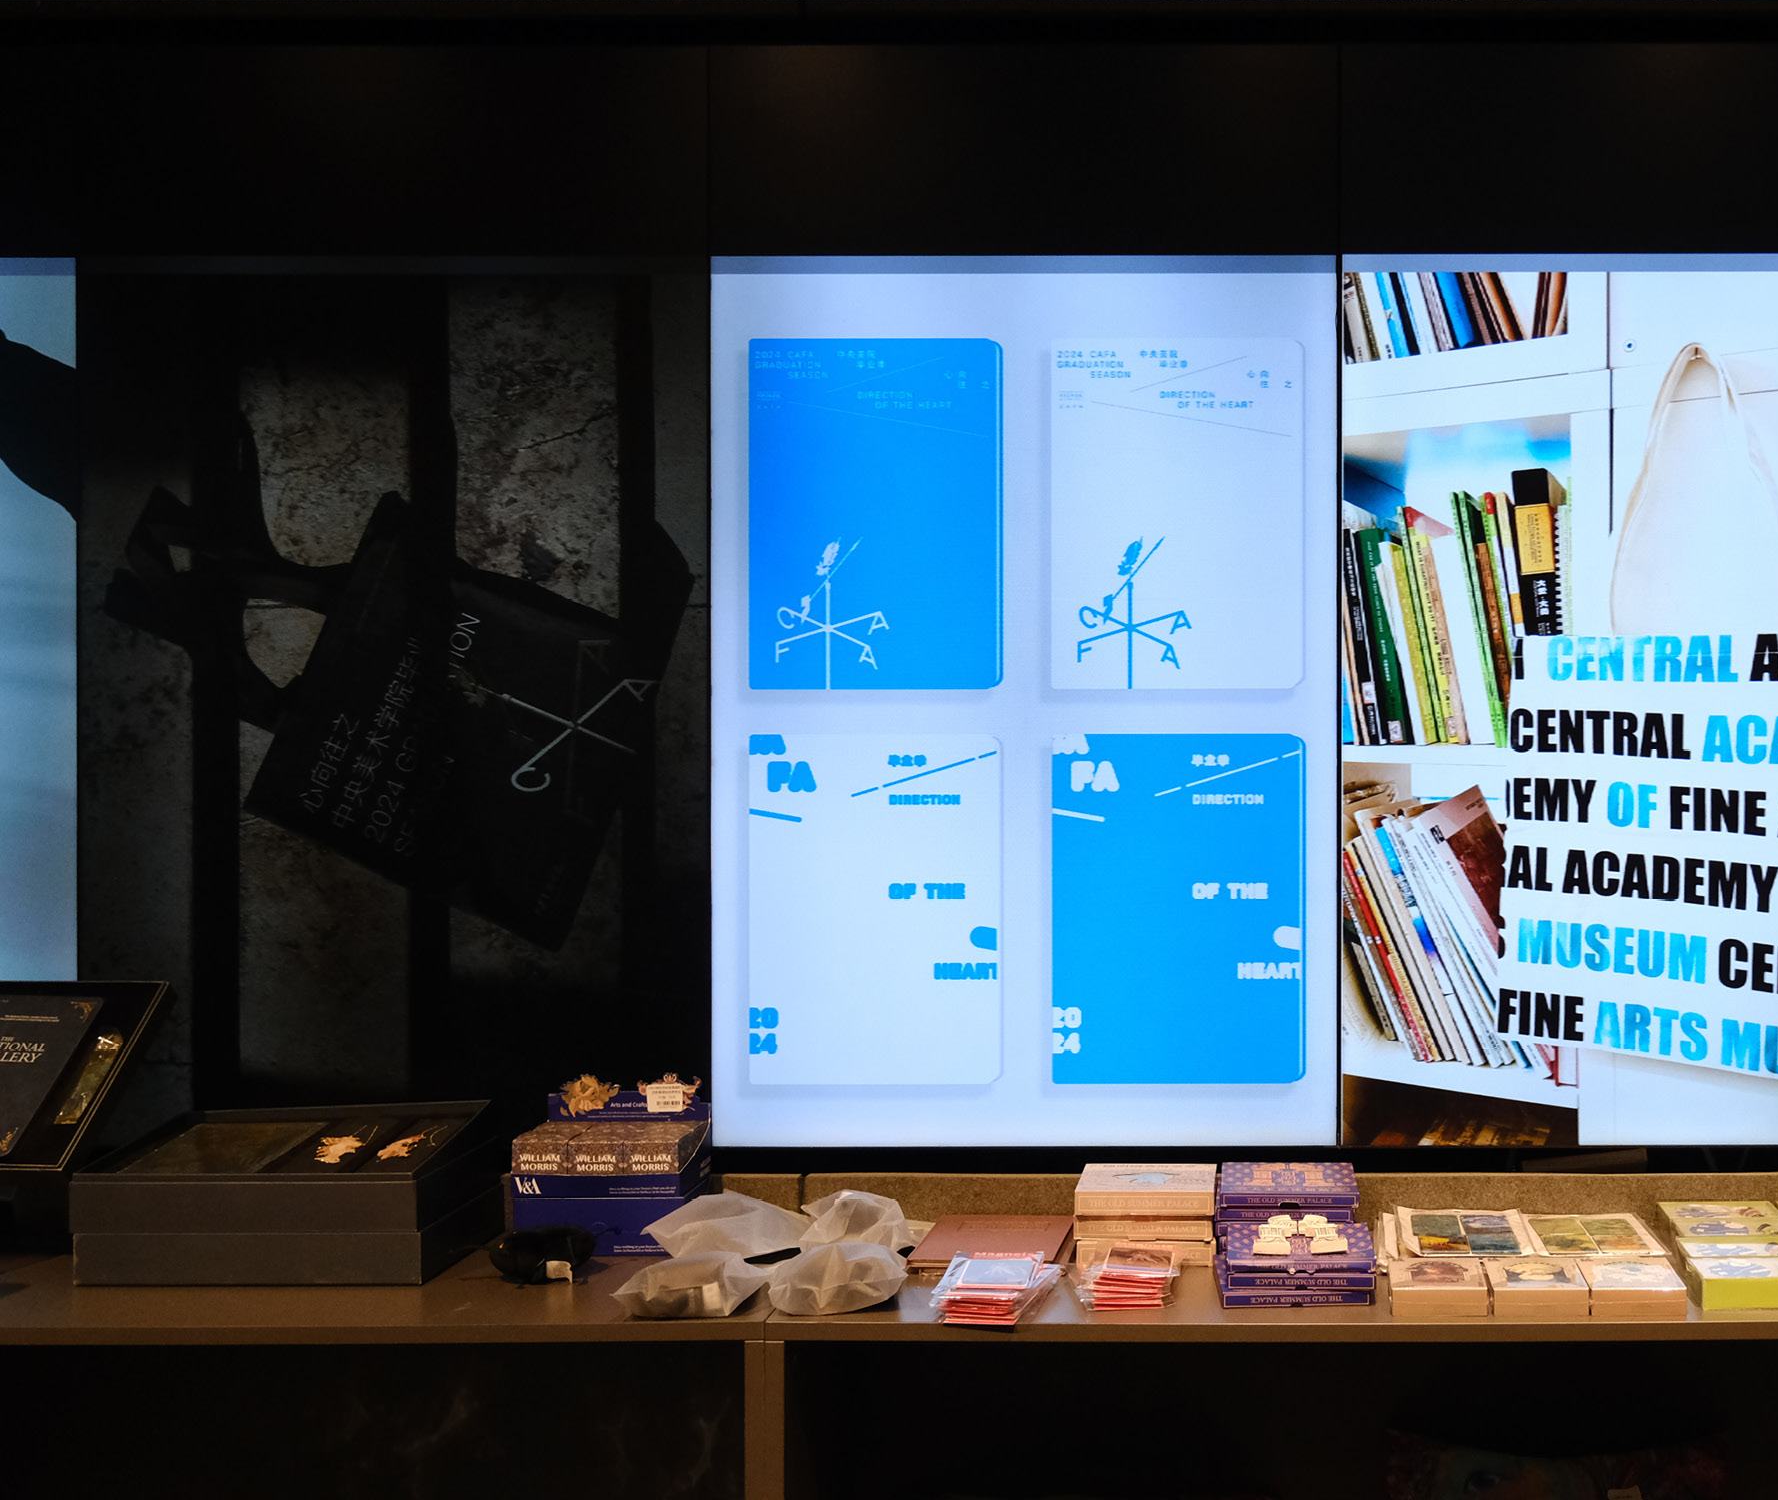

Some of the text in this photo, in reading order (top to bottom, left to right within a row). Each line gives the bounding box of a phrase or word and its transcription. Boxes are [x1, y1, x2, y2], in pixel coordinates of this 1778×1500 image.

[1547, 634, 1739, 683] CENTRAL
[1510, 708, 1691, 760] CENTRAL
[1192, 794, 1264, 806] DIRECTION
[1505, 778, 1596, 824] EMY
[1607, 781, 1658, 829] OF
[1669, 786, 1766, 837] FINE
[1501, 845, 1552, 891] AL
[1563, 850, 1778, 913] ACADEMY
[924, 883, 966, 900] THE
[1192, 883, 1269, 900] OF THE
[1518, 918, 1707, 985] MUSEUM
[1500, 988, 1584, 1042] FINE
[1593, 1001, 1708, 1061] ARTS
[519, 1154, 561, 1163] WILLIAM
[520, 1162, 558, 1171] MORRIS
[575, 1154, 616, 1163] WILLIAM
[630, 1154, 672, 1163] WILLIAM
[632, 1162, 670, 1171] MORRIS
[576, 1163, 614, 1172] MORRIS
[515, 1176, 542, 1195] V&A
